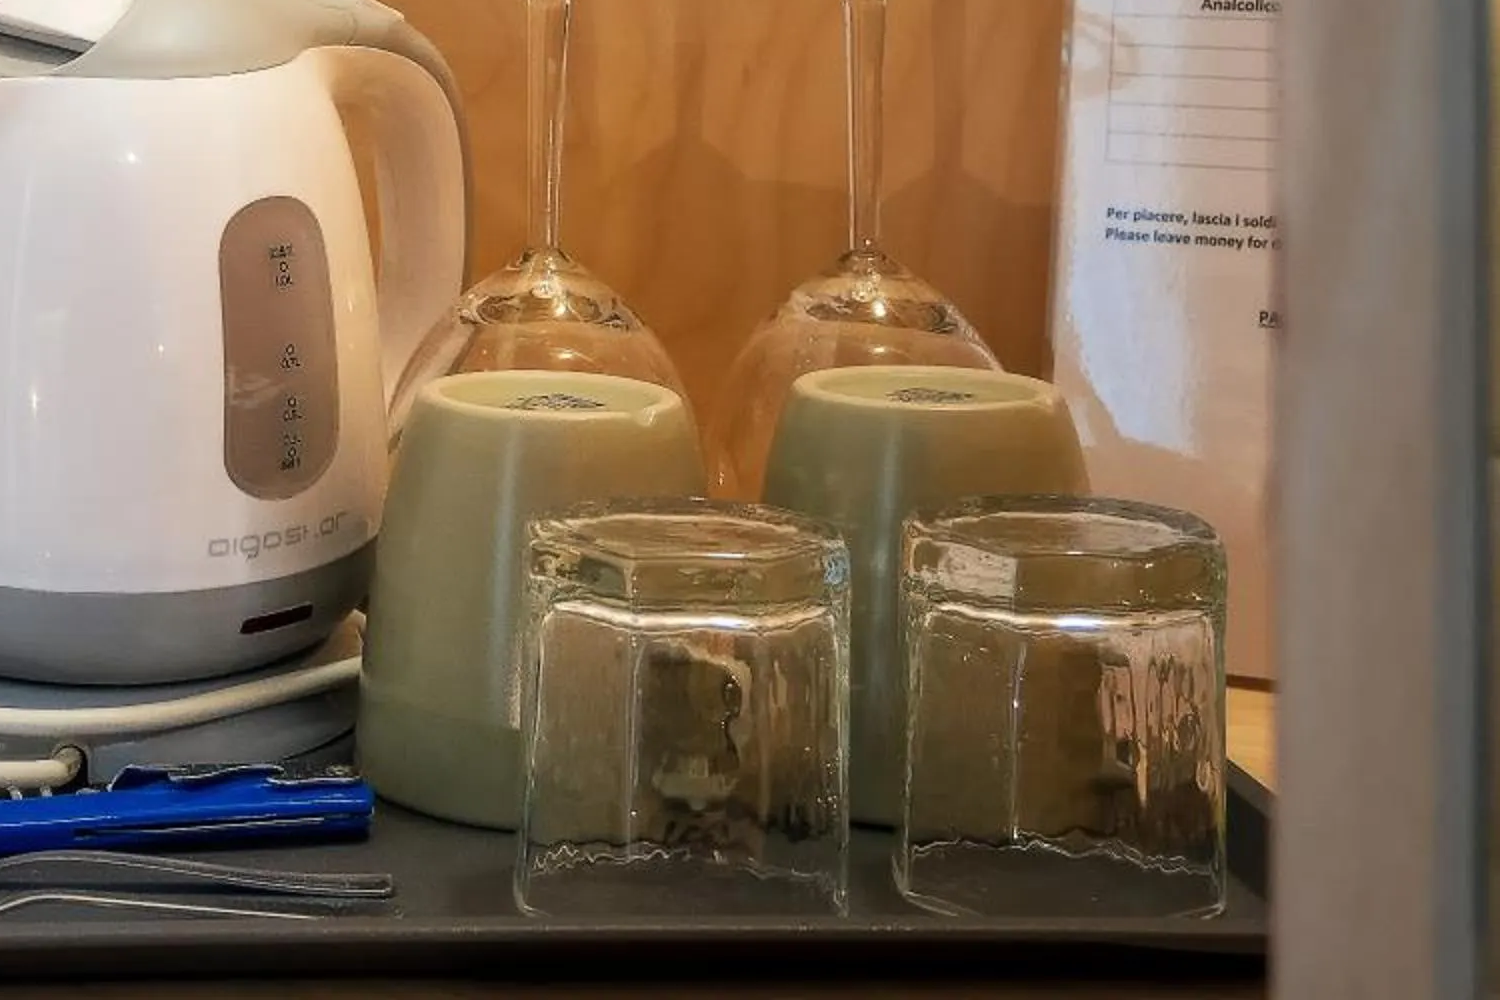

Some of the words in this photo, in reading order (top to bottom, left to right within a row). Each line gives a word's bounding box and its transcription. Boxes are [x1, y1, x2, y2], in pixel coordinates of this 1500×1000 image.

[1106, 207, 1129, 221] Per
[1132, 209, 1189, 226] piacere,
[1192, 210, 1232, 227] lascia
[1105, 227, 1152, 243] Please
[1153, 229, 1191, 245] leave
[1194, 234, 1244, 251] money
[1247, 236, 1269, 249] for
